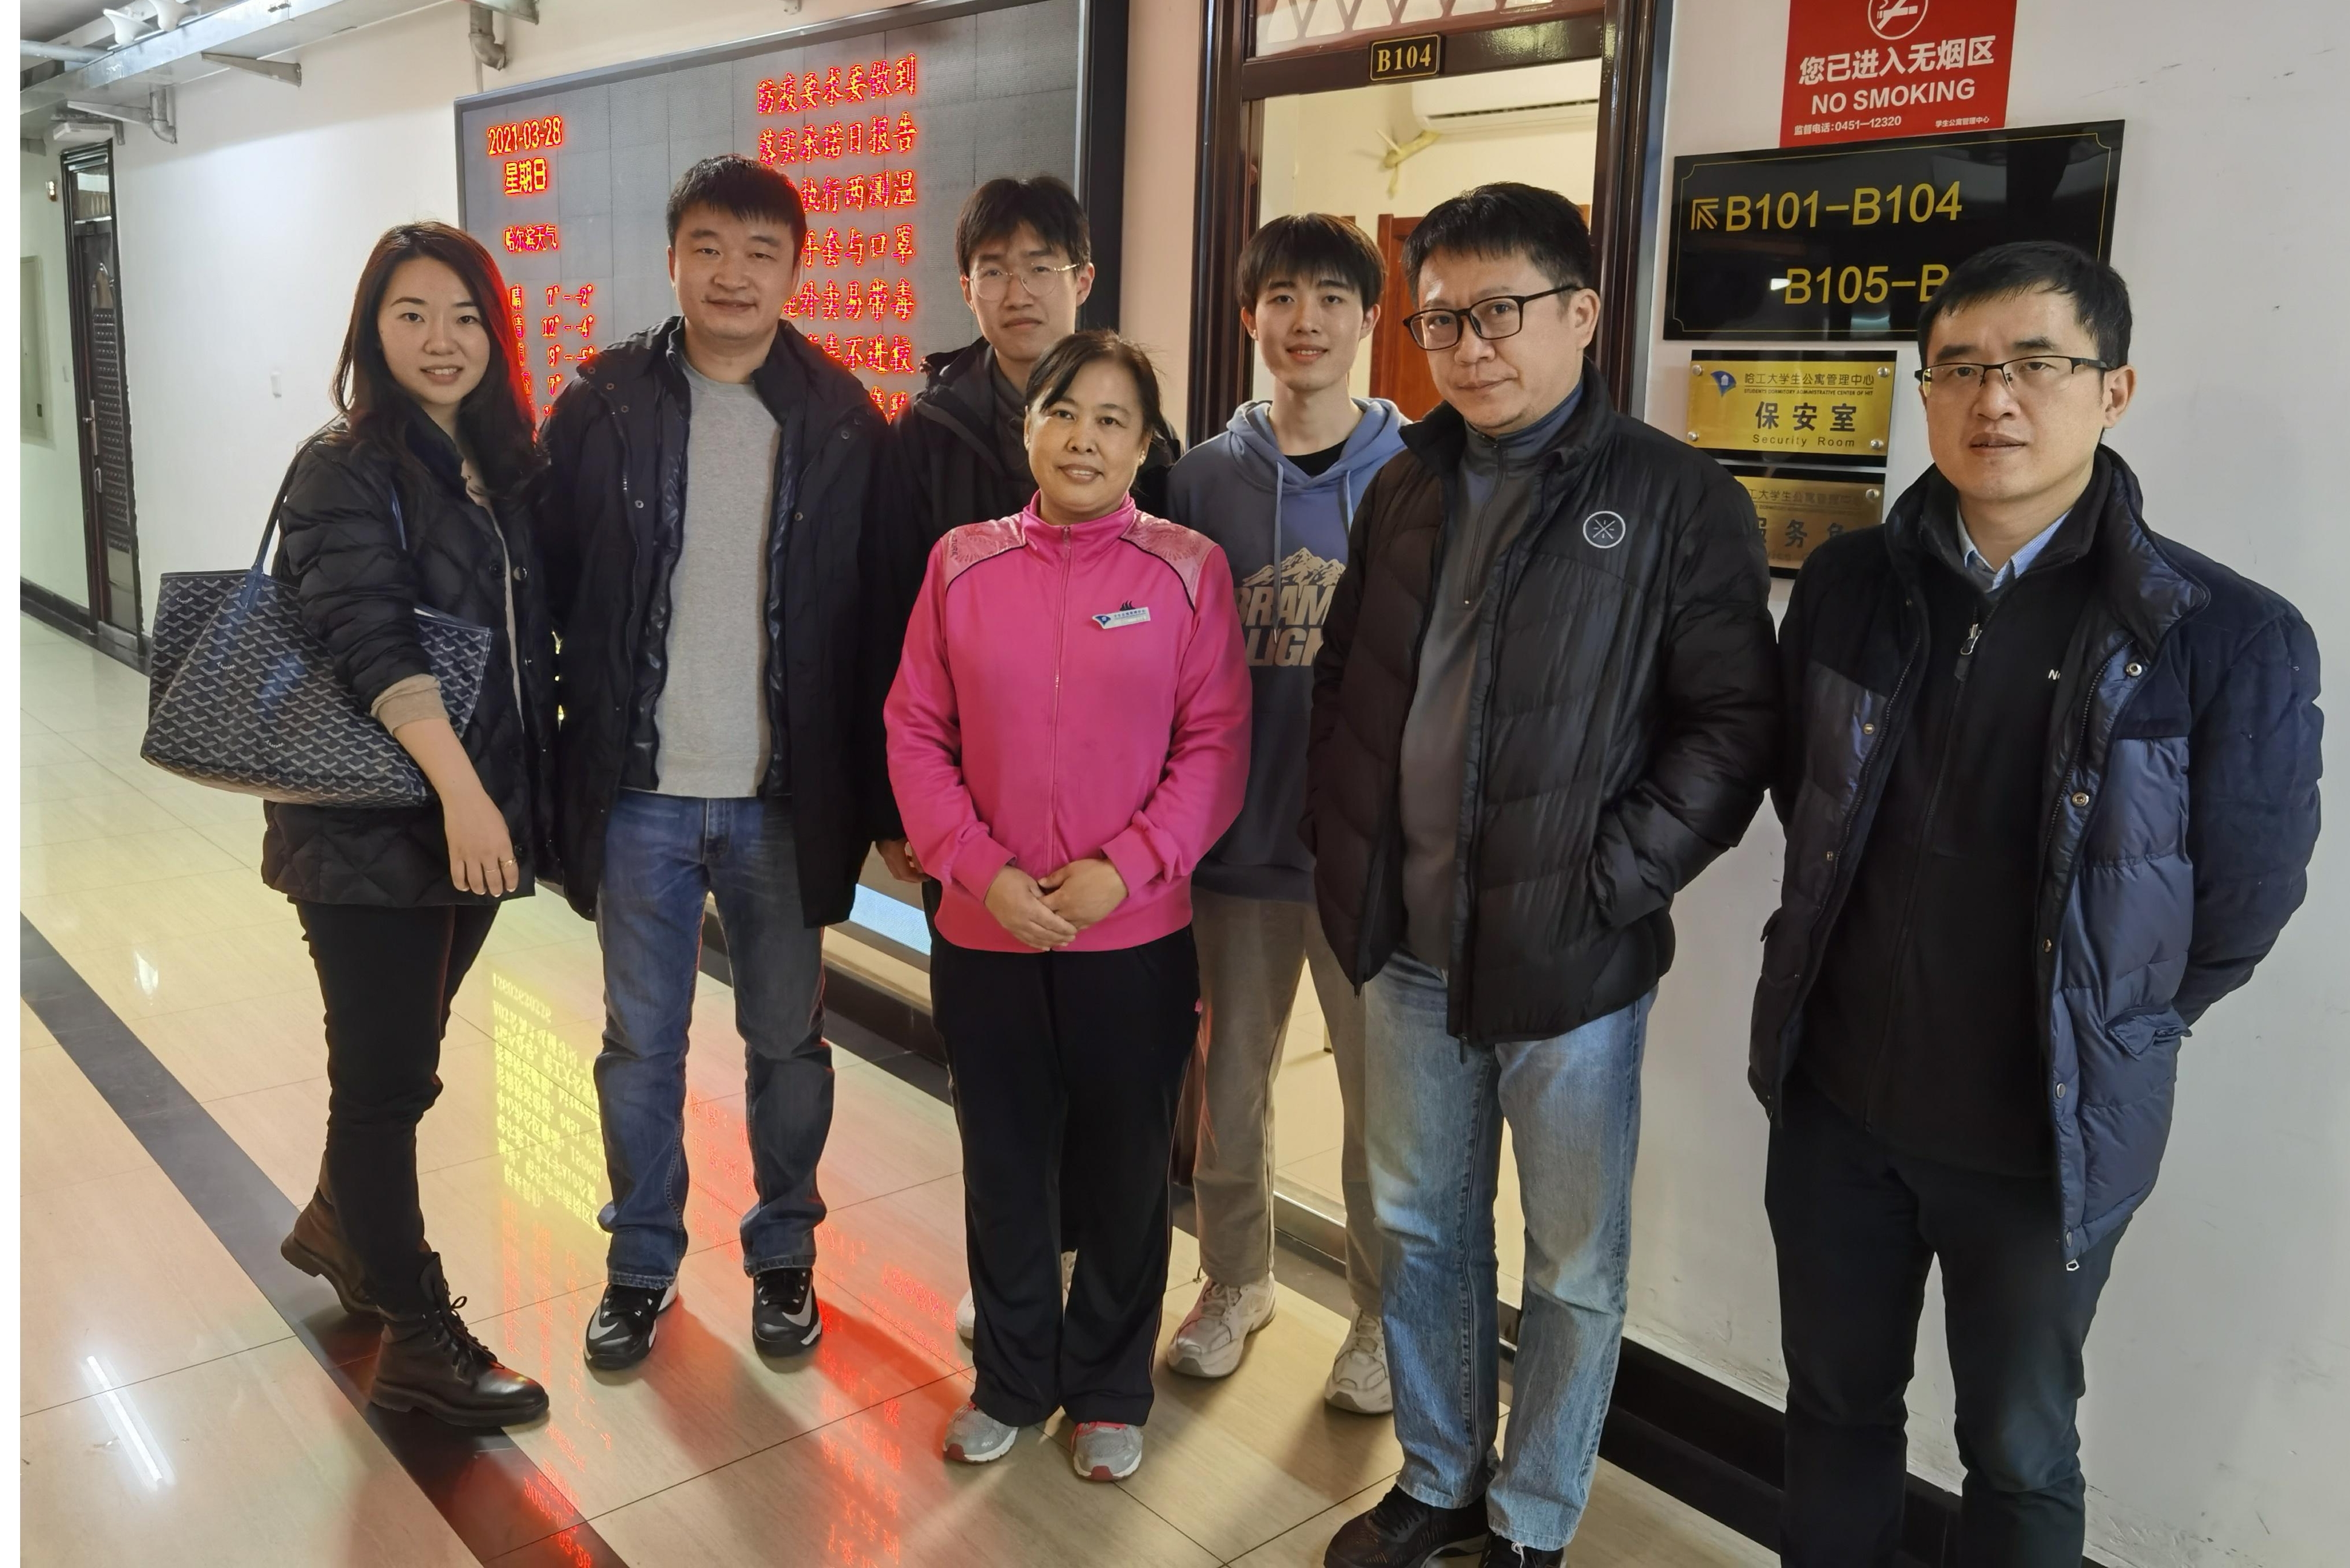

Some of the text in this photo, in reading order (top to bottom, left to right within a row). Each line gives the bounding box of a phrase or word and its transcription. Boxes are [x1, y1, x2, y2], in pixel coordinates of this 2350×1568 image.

[1377, 43, 1431, 72] B104
[1799, 35, 1996, 86] 您已进入无烟区
[757, 52, 917, 115] 防疫要求要做到
[1811, 78, 1976, 115] NO SMOKING
[488, 115, 562, 156] 2021-03-28
[758, 111, 918, 167] 落实承诺日报告
[1935, 116, 1990, 128] 学生公寓管理中心
[504, 156, 548, 195] 星期日
[504, 223, 558, 253] 哈尔滨天气
[802, 223, 915, 268] 手套与口罩
[1744, 373, 1874, 386] 哈工大学生公寓管理中心
[1755, 401, 1857, 432] 保安室
[1752, 434, 1855, 447] Security Room
